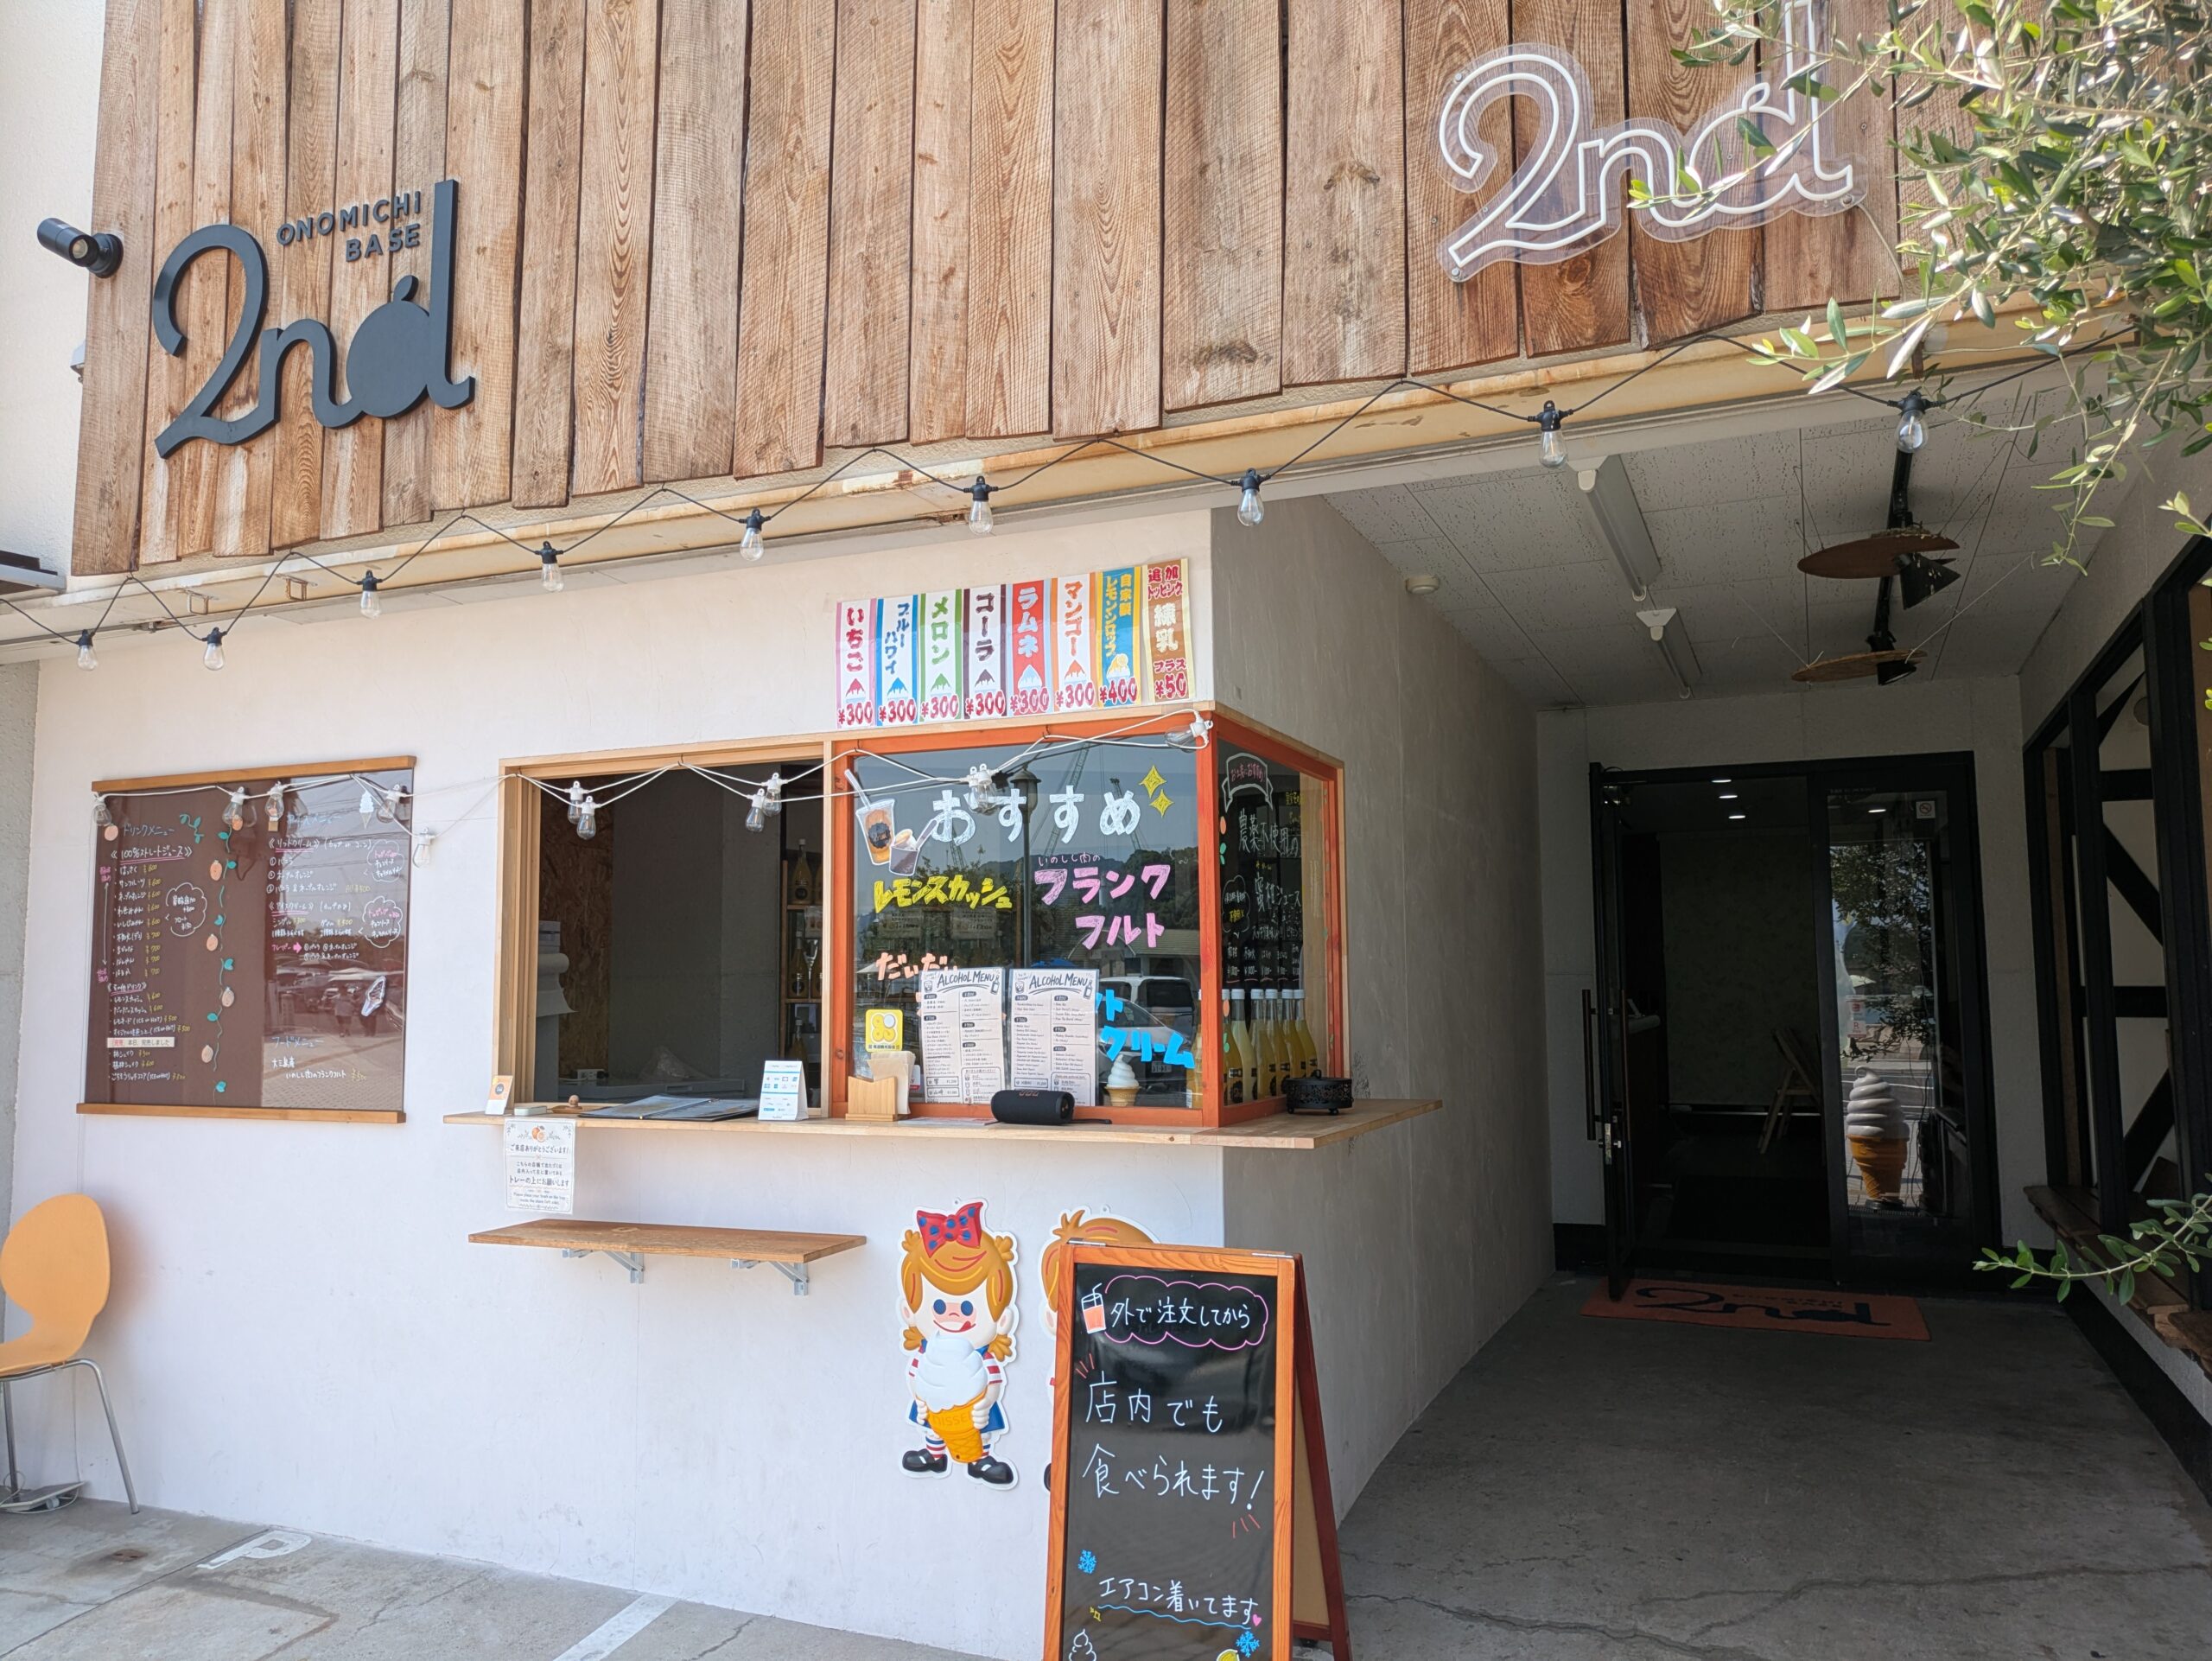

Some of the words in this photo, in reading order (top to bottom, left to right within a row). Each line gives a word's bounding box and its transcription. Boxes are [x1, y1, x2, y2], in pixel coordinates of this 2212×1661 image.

[1438, 0, 1853, 269] 2nd
[276, 191, 421, 246] ONOMICHI
[346, 223, 421, 262] BASE
[152, 178, 475, 459] 2nd
[1147, 581, 1183, 600] トッピング
[1148, 565, 1179, 582] 追加
[1119, 574, 1132, 616] 自家製
[896, 602, 910, 648] ブルー
[931, 596, 950, 665] メロン
[975, 593, 995, 661] コーラ
[1017, 587, 1039, 658] ラムネ
[1064, 581, 1083, 656] マンゴー
[1104, 576, 1118, 657] レモンシロップ
[1154, 602, 1179, 653] 練乳
[846, 607, 864, 672] いちご
[884, 631, 898, 675] ハワイ
[966, 690, 1005, 716] ¥300
[1009, 687, 1050, 714] ¥300
[1056, 682, 1096, 709] ¥300
[1099, 678, 1138, 704] ¥400
[1154, 672, 1187, 699] ¥50
[838, 701, 874, 726] ¥300
[879, 698, 916, 723] ¥300
[921, 695, 959, 719] ¥300
[123, 823, 176, 837] ドリンクメニュー
[931, 785, 1142, 845] おすすめ
[1039, 851, 1101, 867] いのしし肉の
[874, 874, 1013, 914] レモンスカッシュ
[1033, 863, 1172, 906] フランク
[1074, 913, 1166, 950] フルト
[875, 951, 958, 982] だいだ
[937, 971, 972, 988] ALCOHOL
[971, 970, 995, 983] MENU
[1028, 973, 1065, 990] ALCOHOL
[1064, 972, 1088, 987] MENU
[1099, 1025, 1197, 1069] クリーム
[1109, 1296, 1251, 1329] 外で注文してから
[1085, 1370, 1224, 1434] 店内でも
[1082, 1442, 1265, 1511] 食べられます!
[197, 1531, 313, 1570] P
[1099, 1577, 1260, 1626] エアコン着いてます
